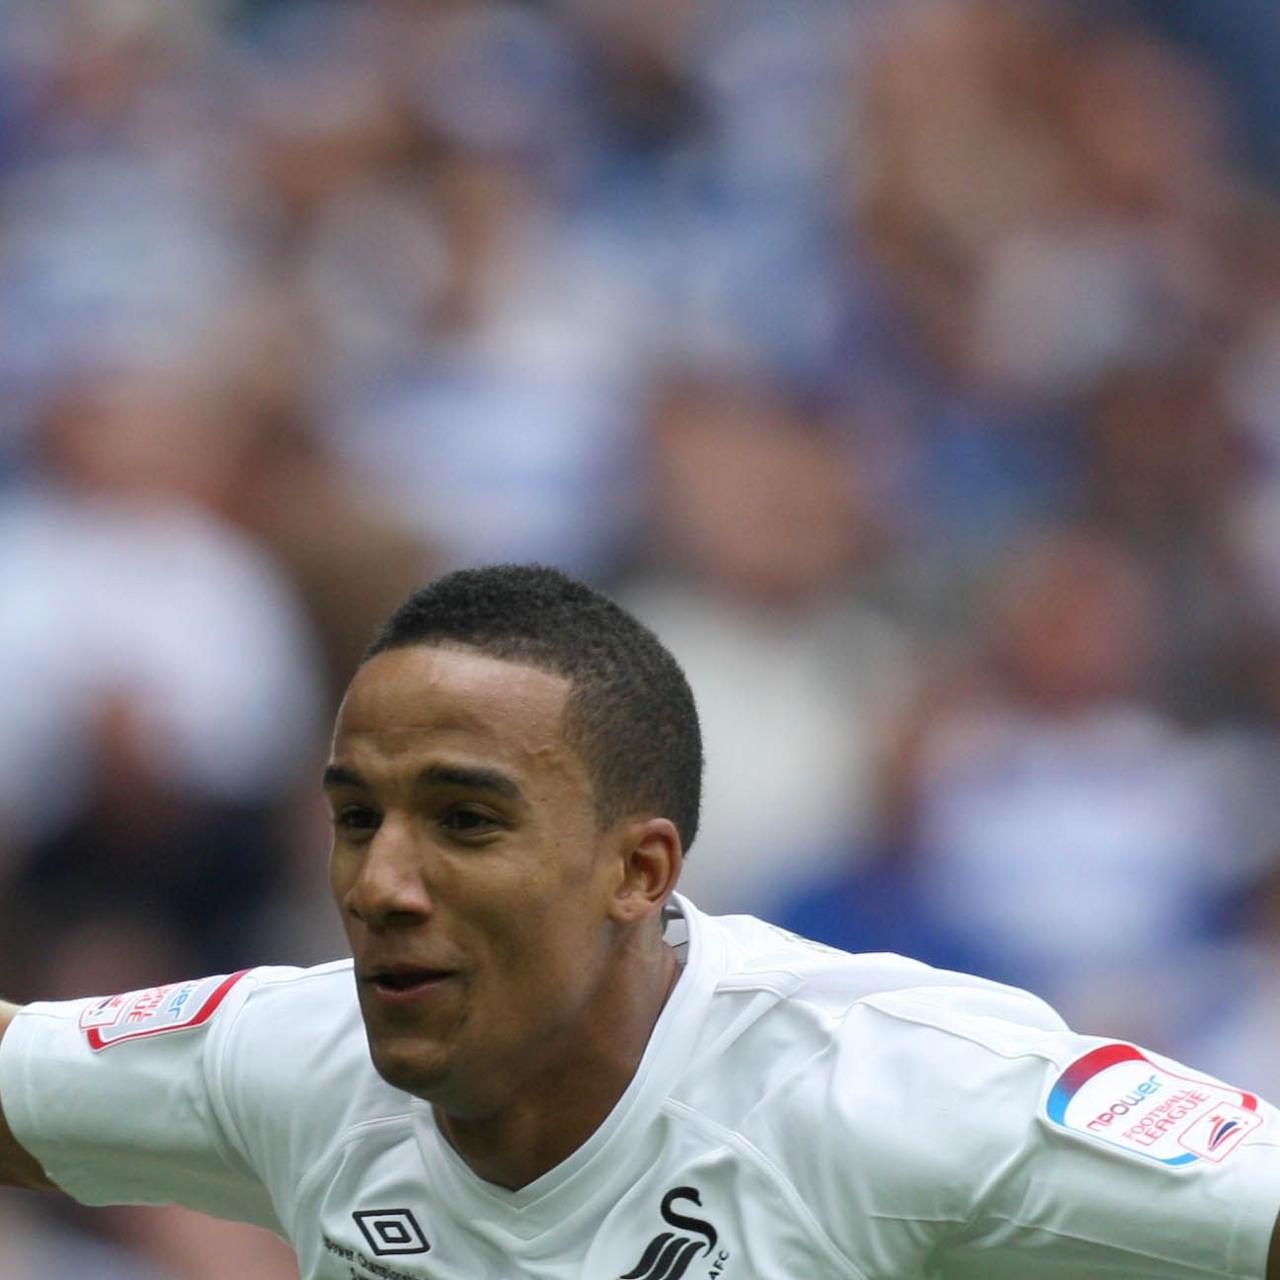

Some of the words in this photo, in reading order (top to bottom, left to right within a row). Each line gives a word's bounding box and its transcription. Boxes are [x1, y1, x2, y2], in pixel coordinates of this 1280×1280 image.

[1086, 1074, 1164, 1132] npower
[1121, 1089, 1191, 1142] FOOTBALL
[1135, 1089, 1211, 1147] LEAGUE
